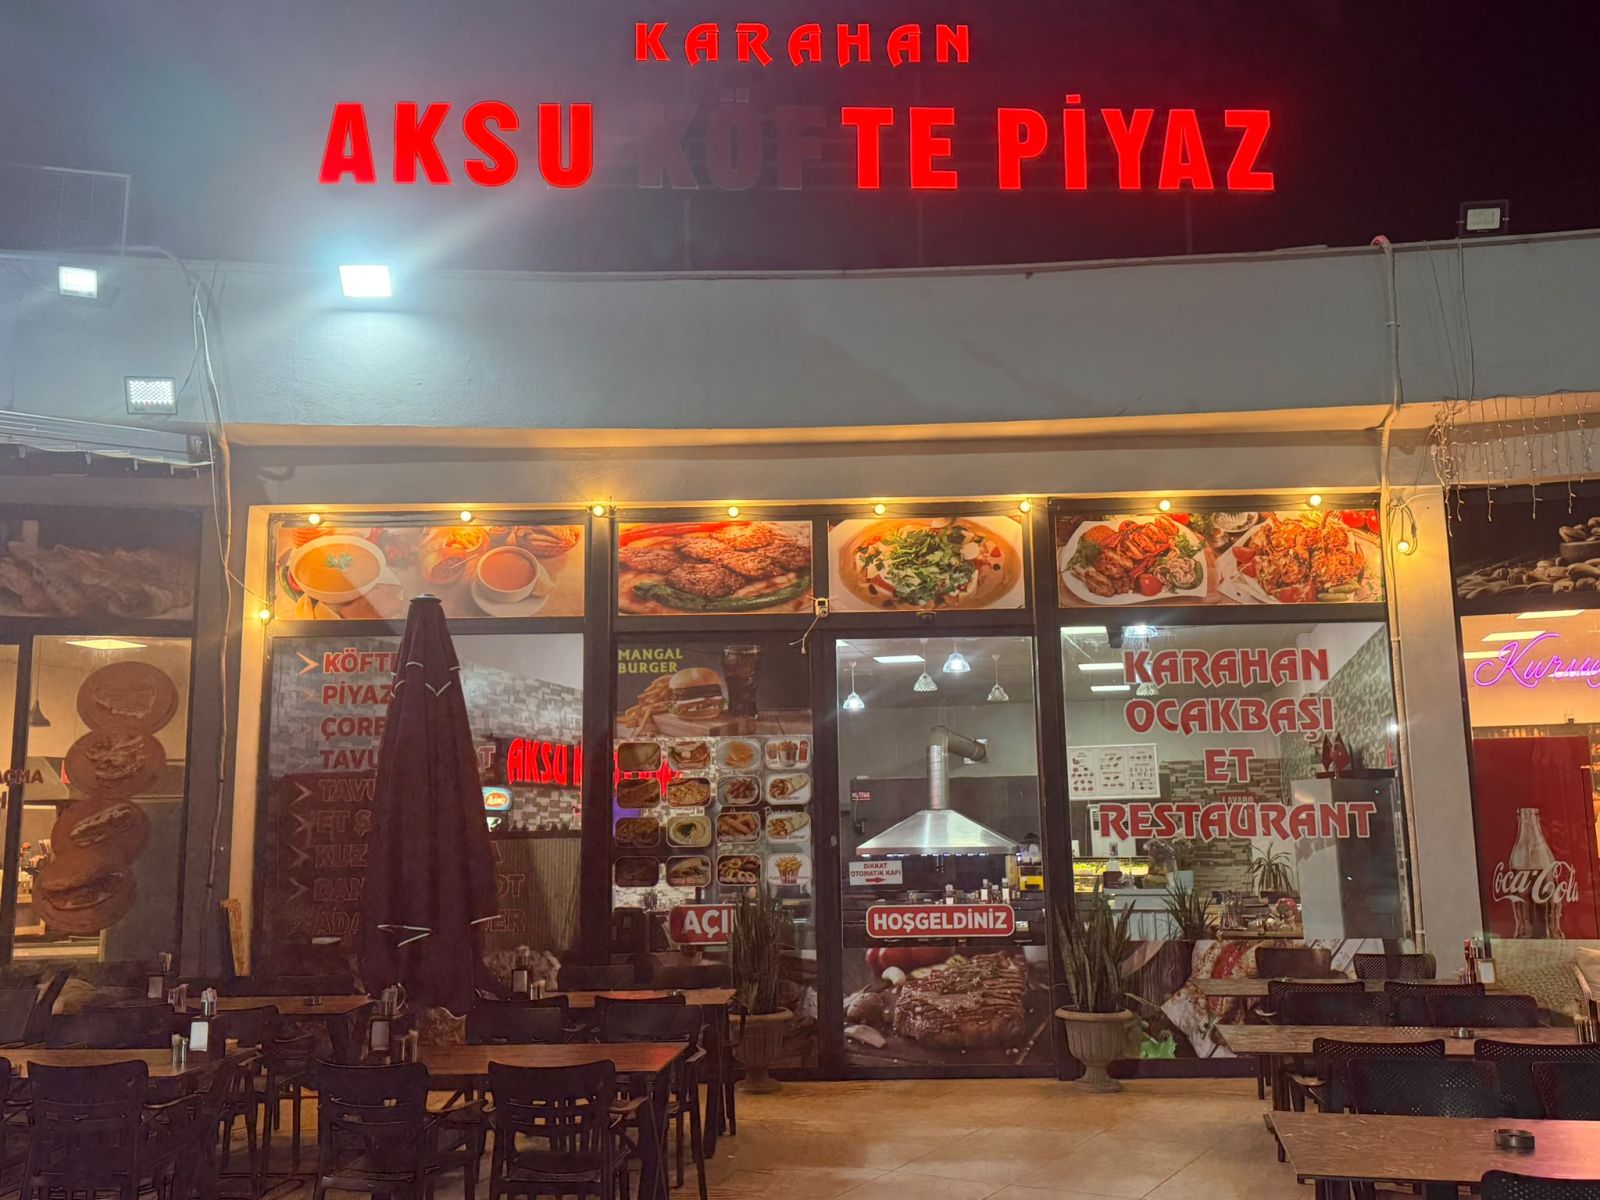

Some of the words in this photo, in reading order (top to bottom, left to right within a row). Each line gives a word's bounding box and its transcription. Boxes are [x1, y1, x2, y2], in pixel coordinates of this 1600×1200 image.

[634, 23, 971, 67] KARAHAN
[318, 100, 595, 188] AKSU
[997, 94, 1276, 193] PİYAZ
[617, 648, 683, 661] MANGAL
[617, 662, 678, 674] BURGER
[1125, 649, 1329, 687] KARAHAN
[1124, 698, 1335, 742] OCAKBAŞI
[506, 737, 568, 786] AKSU
[1204, 748, 1255, 783] ET
[1100, 803, 1376, 841] RESTAURANT
[874, 909, 1008, 932] HOŞGELDİNİZ
